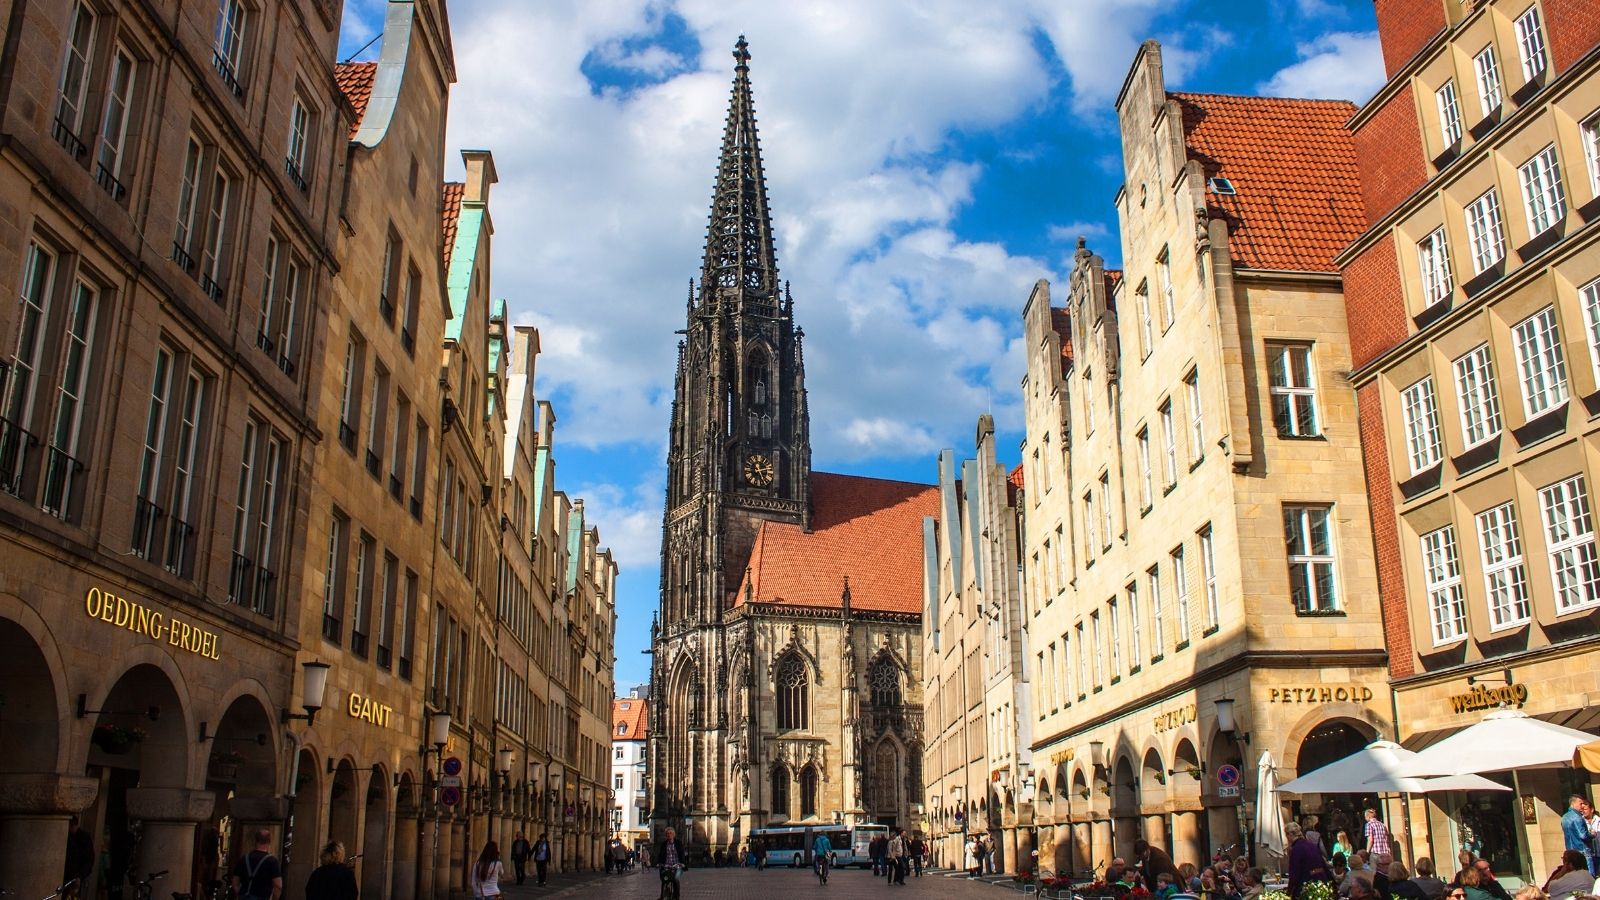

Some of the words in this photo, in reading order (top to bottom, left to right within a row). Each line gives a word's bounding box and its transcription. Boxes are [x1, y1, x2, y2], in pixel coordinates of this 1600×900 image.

[86, 587, 220, 660] OEDING-ERDEL
[349, 692, 393, 728] GANT
[1269, 687, 1373, 702] PETZHOLD
[1449, 684, 1528, 713] weitkamp
